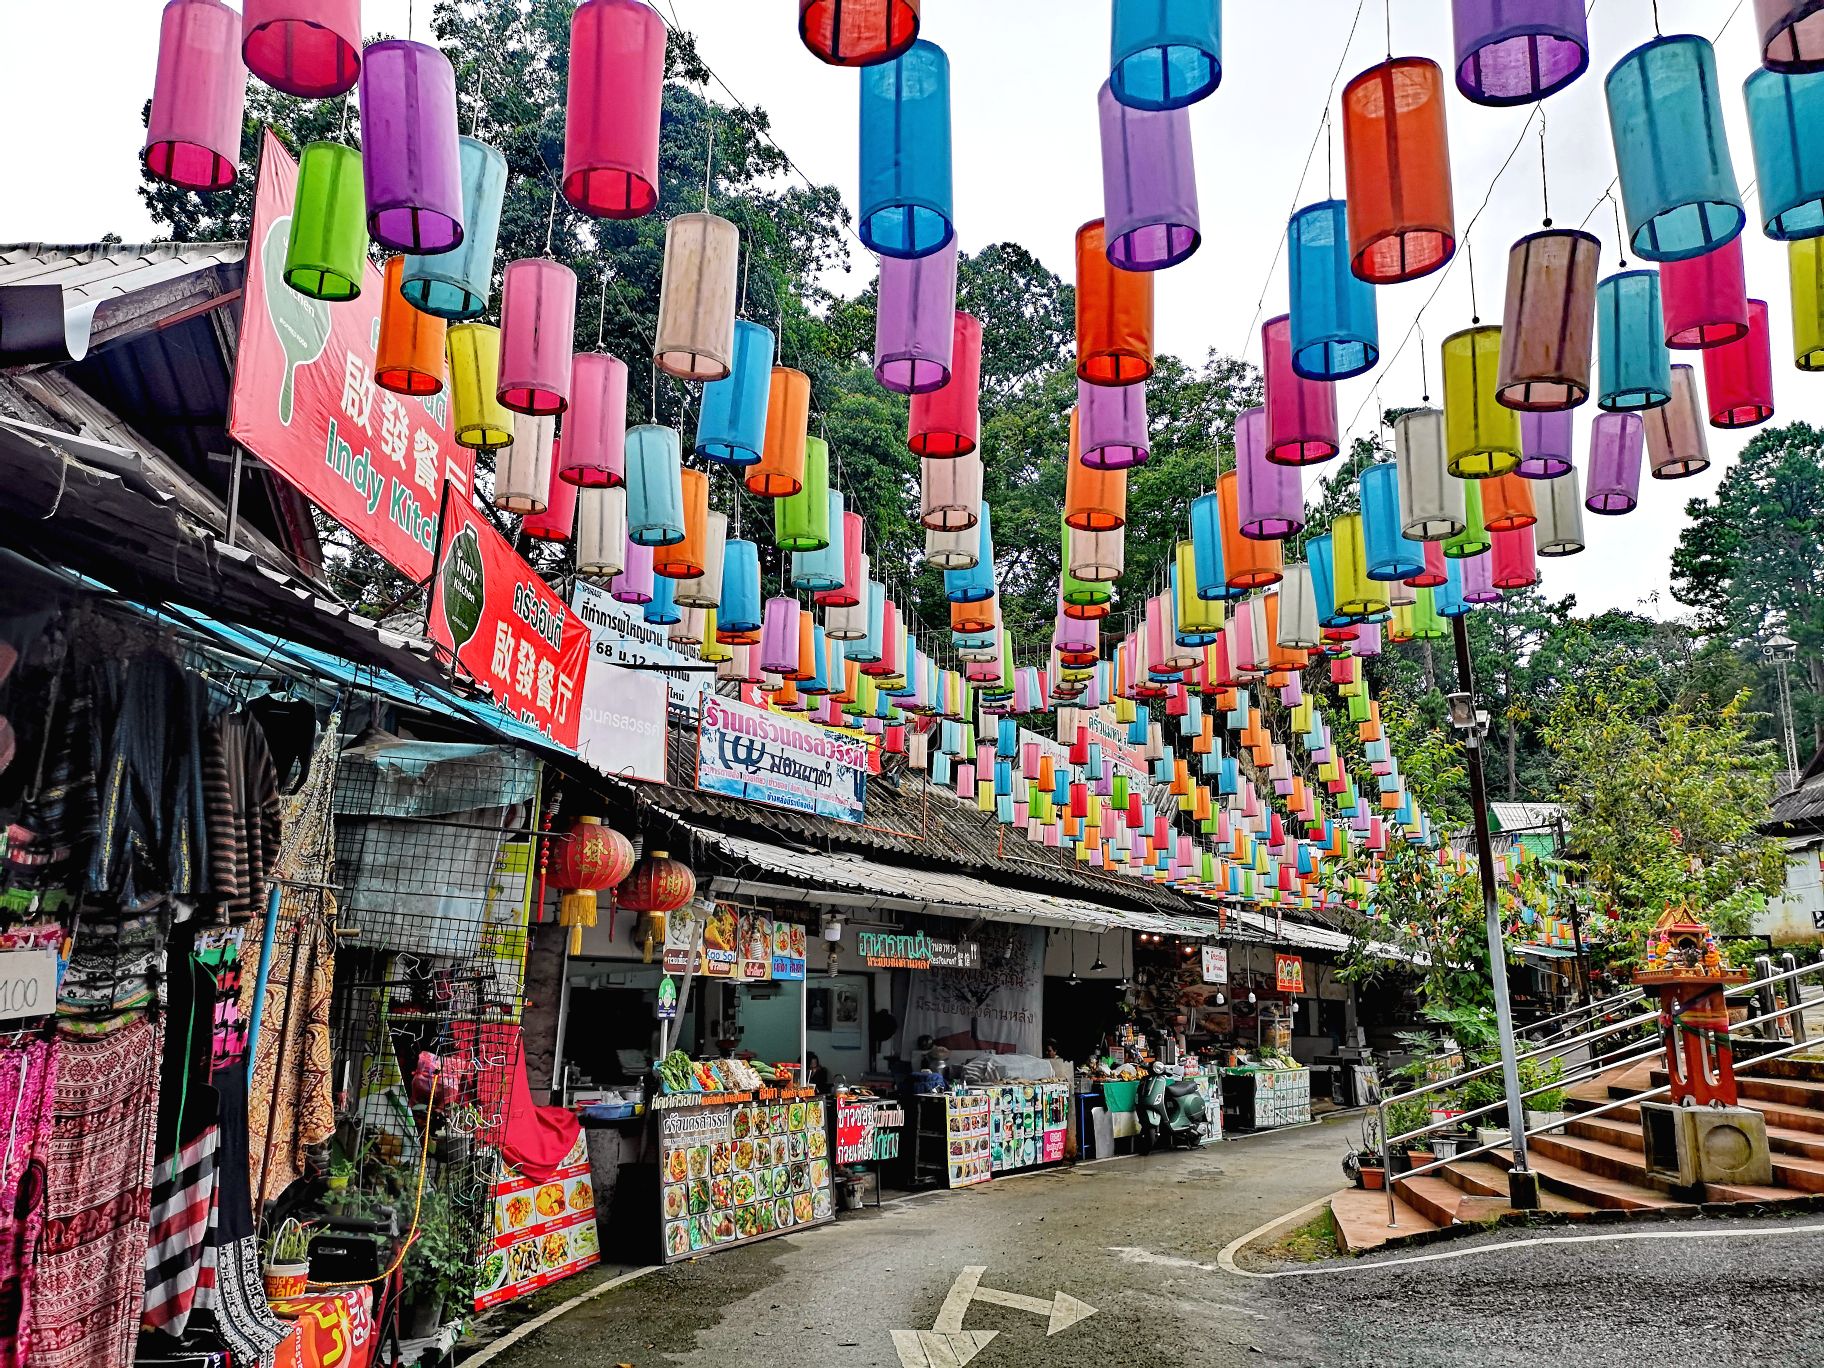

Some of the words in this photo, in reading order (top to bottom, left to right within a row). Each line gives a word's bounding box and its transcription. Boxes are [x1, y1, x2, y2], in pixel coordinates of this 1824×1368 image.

[325, 416, 385, 515] Indy
[456, 549, 478, 586] INDY
[453, 576, 476, 604] Kitchen
[512, 581, 565, 653] ครัวอินดี้
[595, 642, 613, 658] 68
[705, 698, 865, 770] ร้านครัวนครสวรรค์
[583, 838, 608, 866] 發
[931, 941, 957, 954] านอาหาร
[0, 977, 38, 1012] 100
